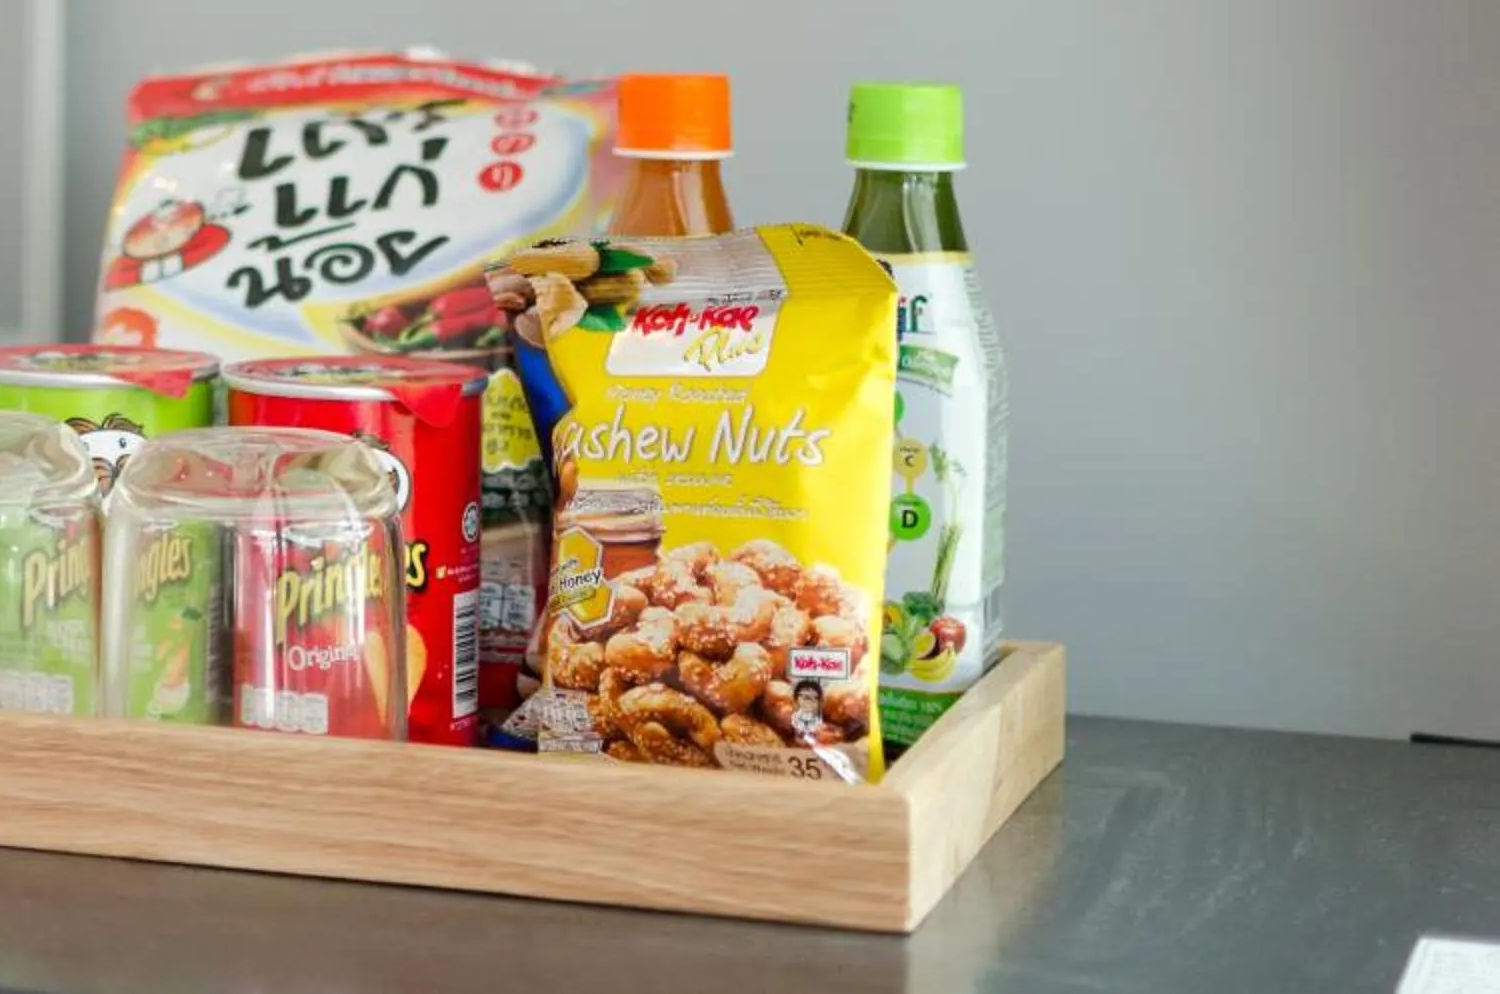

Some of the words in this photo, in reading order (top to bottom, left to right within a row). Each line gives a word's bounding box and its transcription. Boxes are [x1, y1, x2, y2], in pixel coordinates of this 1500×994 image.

[708, 403, 829, 465] Nuts
[901, 510, 919, 529] D
[787, 754, 822, 781] 35
